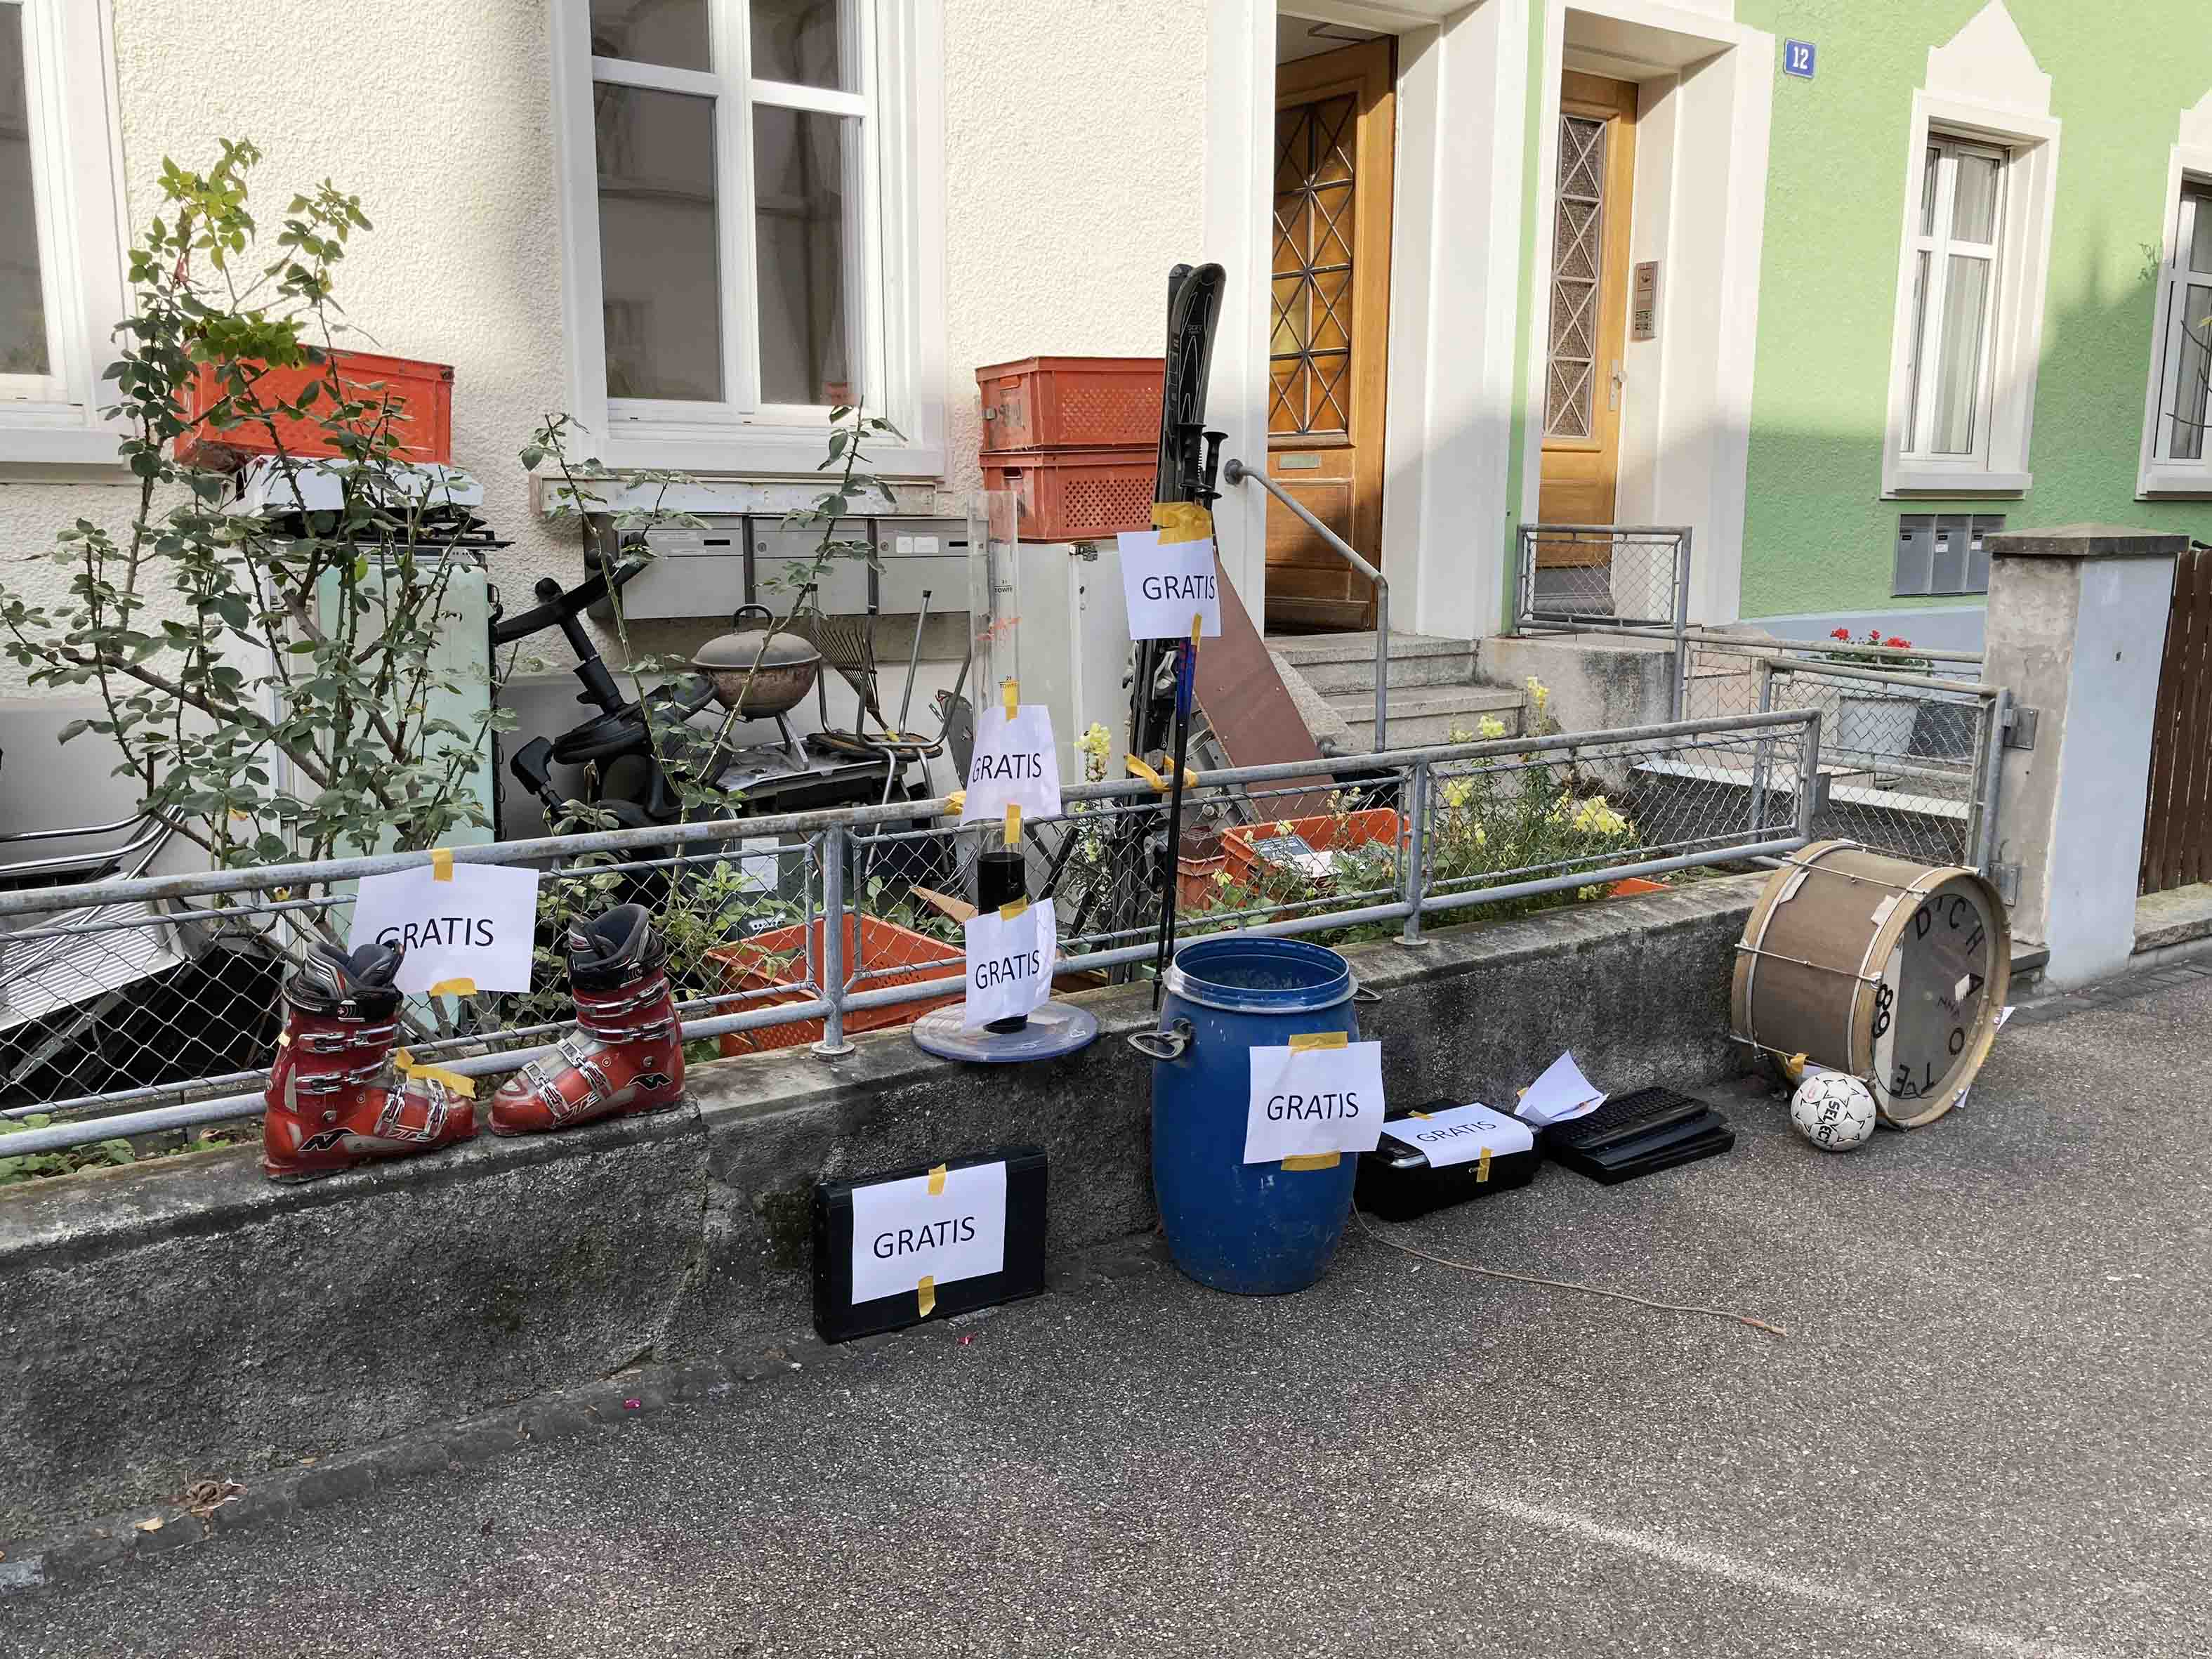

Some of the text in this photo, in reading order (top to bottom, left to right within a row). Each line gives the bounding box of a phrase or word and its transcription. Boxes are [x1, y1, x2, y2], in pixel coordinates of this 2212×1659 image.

[1792, 46, 1808, 69] 12
[1142, 575, 1215, 601] GRATIS
[973, 753, 1041, 782] GRATIS
[975, 950, 1039, 989] GRATIS
[1267, 1092, 1359, 1120] GRATIS
[1416, 1121, 1497, 1141] GRATIS
[1816, 1100, 1841, 1144] SELECT
[874, 1216, 975, 1259] GRATIS
